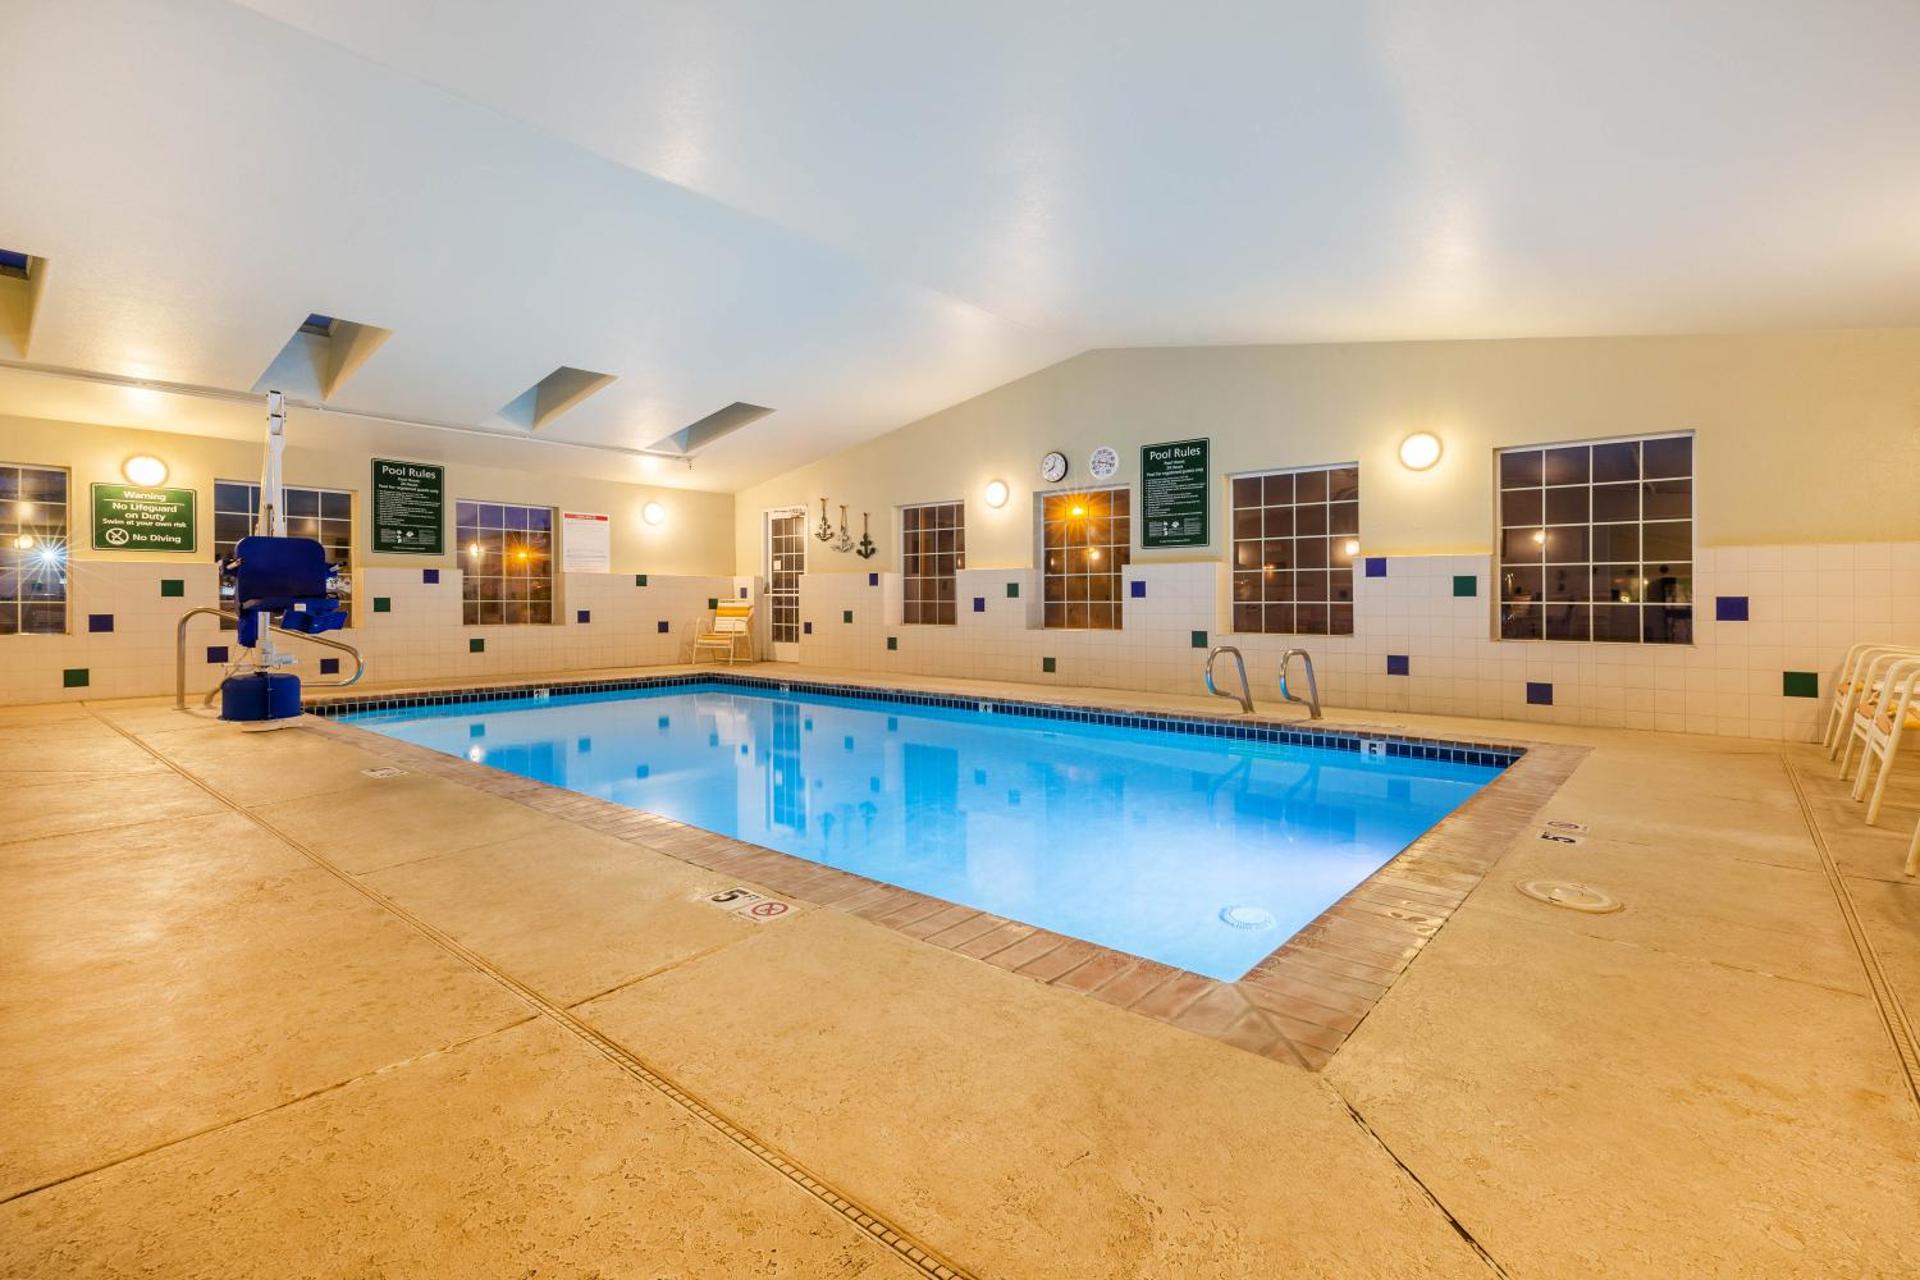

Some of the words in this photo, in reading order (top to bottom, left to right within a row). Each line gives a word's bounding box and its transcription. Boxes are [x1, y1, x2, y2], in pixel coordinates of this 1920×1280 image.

[1150, 448, 1171, 460] Pool
[1174, 446, 1201, 458] Rules
[382, 465, 406, 476] Pool
[409, 468, 436, 479] Rules
[123, 490, 167, 502] Warning
[112, 502, 128, 511] No
[130, 503, 177, 513] Lifeguard
[141, 512, 166, 521] Duty
[132, 533, 147, 541] No
[150, 534, 182, 544] Diving
[711, 888, 750, 903] 5
